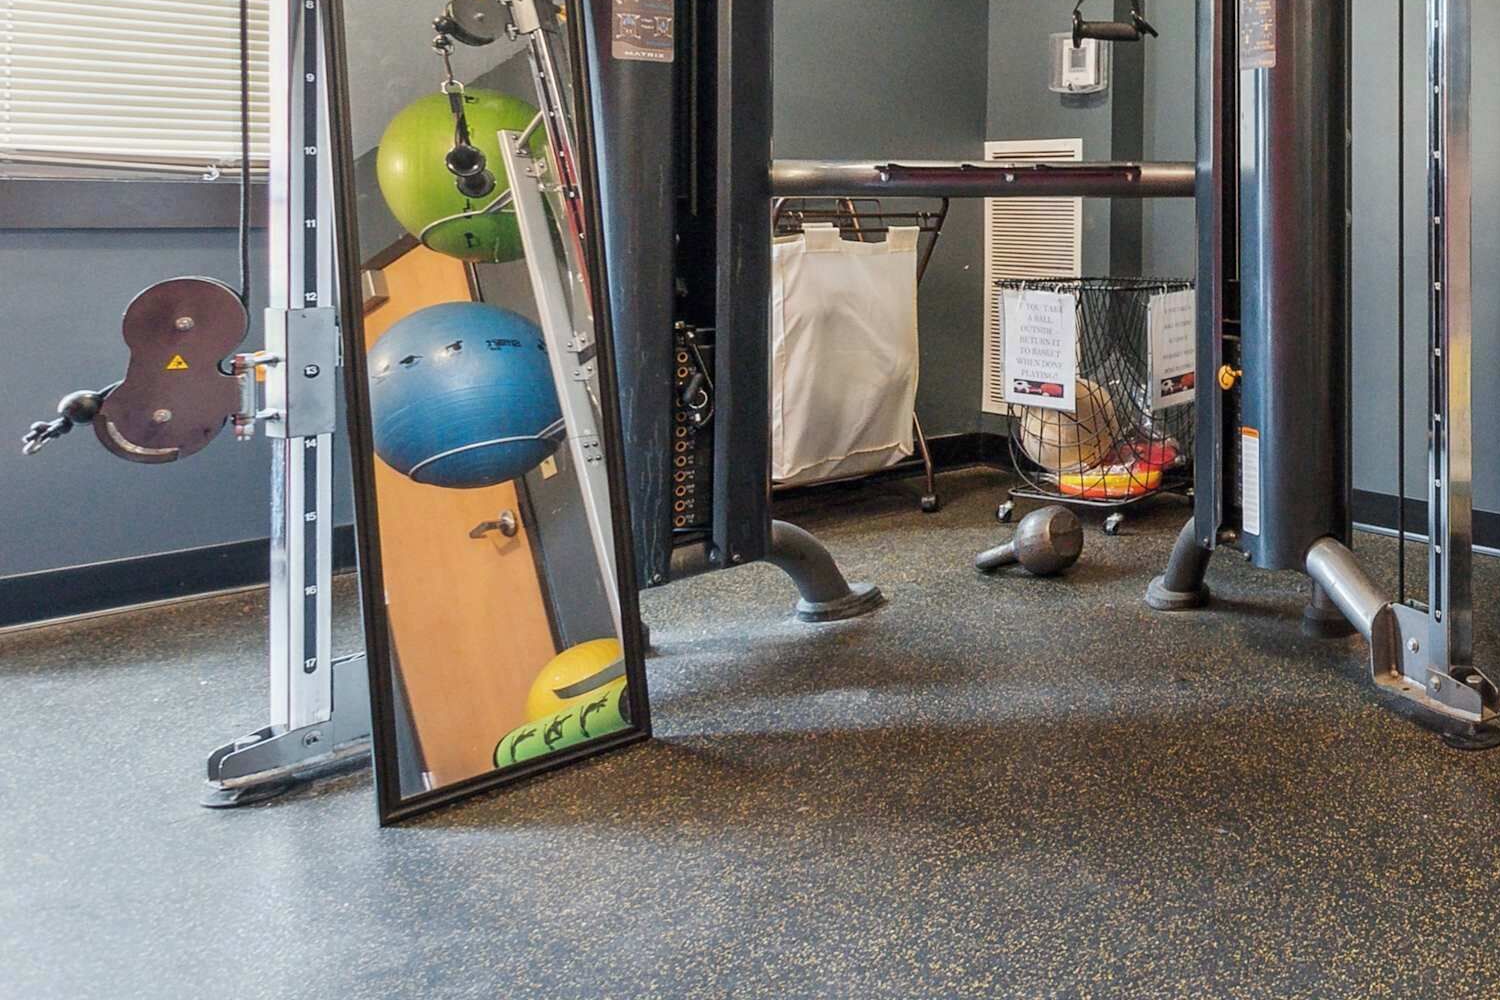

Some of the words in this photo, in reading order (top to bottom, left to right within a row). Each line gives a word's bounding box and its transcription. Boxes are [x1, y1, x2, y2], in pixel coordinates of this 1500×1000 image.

[305, 0, 315, 9] 8
[624, 50, 665, 59] MATRIX
[305, 73, 315, 82] 9
[304, 146, 317, 155] 10
[304, 219, 317, 228] 11
[304, 292, 317, 301] 12
[304, 366, 318, 376] 13
[304, 438, 317, 448] 14
[304, 511, 317, 521] 15
[304, 658, 317, 668] 17
